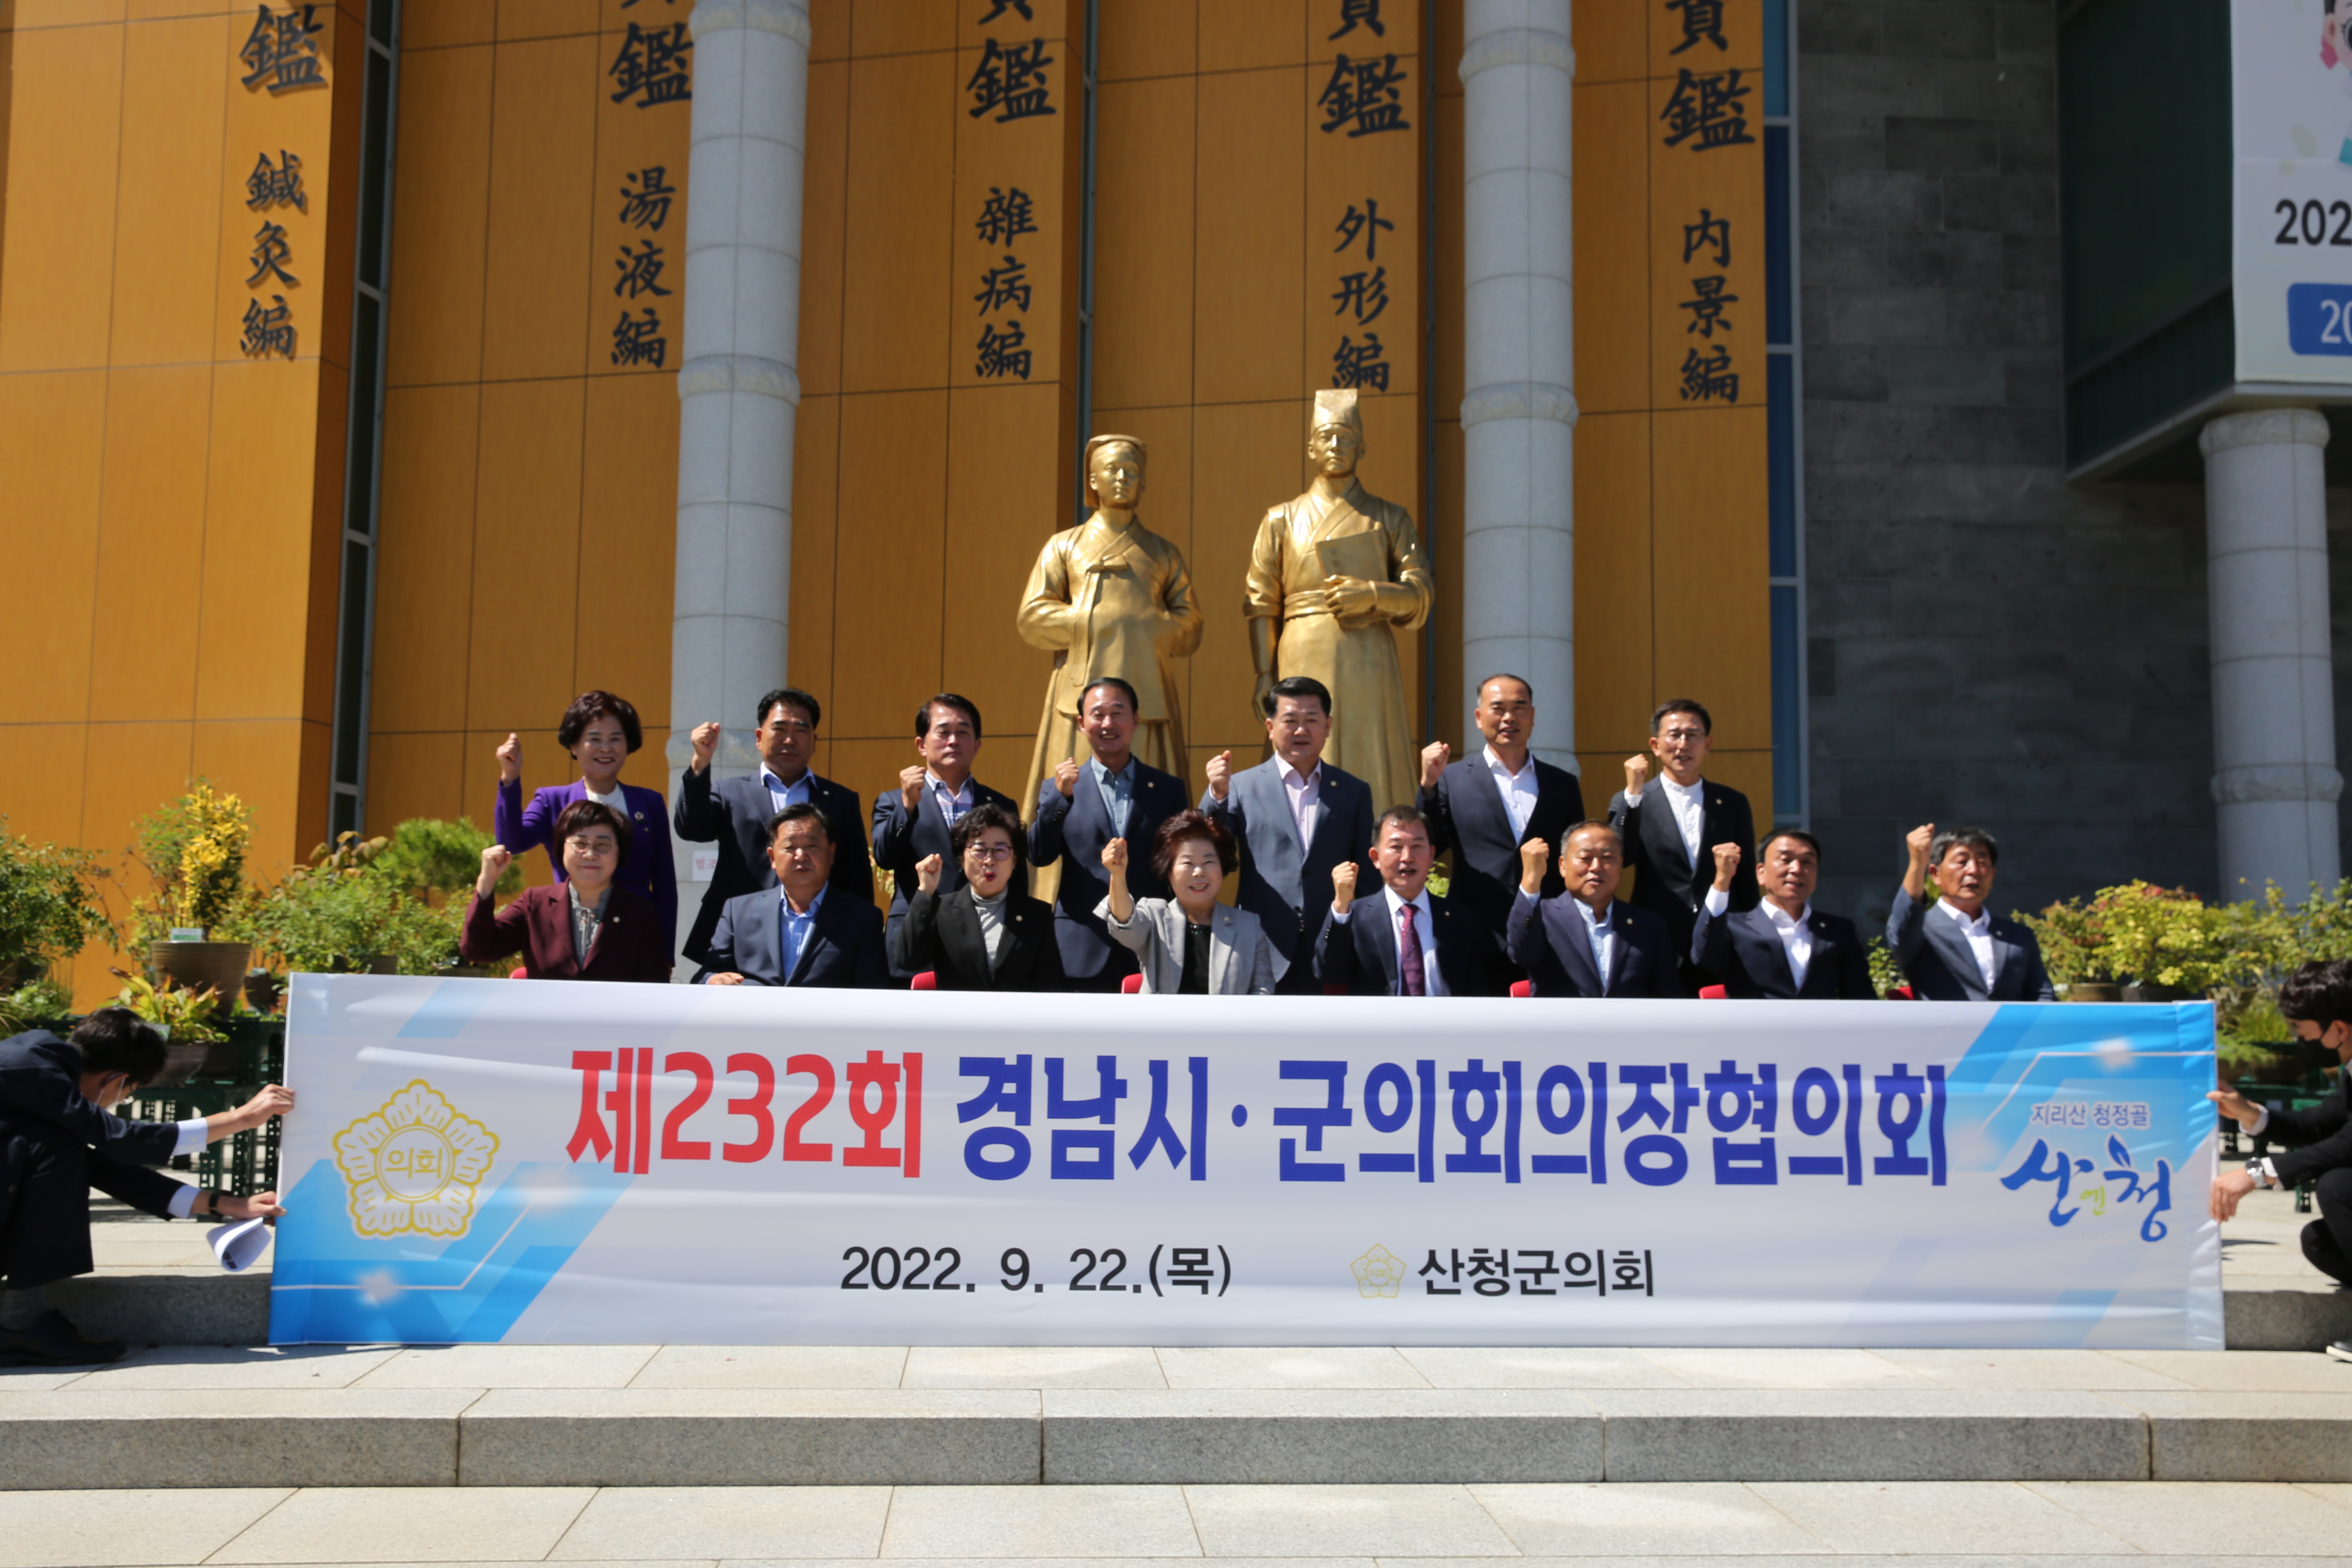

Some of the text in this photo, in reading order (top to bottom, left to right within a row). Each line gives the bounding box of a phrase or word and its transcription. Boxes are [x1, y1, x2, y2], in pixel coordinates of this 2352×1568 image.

[966, 0, 1056, 123] 鑑
[608, 0, 693, 368] 鑑 湯液編
[566, 1047, 923, 1178] 제232회
[2032, 1104, 2148, 1126] 지리산 청정골
[385, 1147, 443, 1179] 의회
[841, 1244, 1231, 1297] 2022. 9. 22.(목)
[1418, 1248, 1654, 1297] 산청군의회
